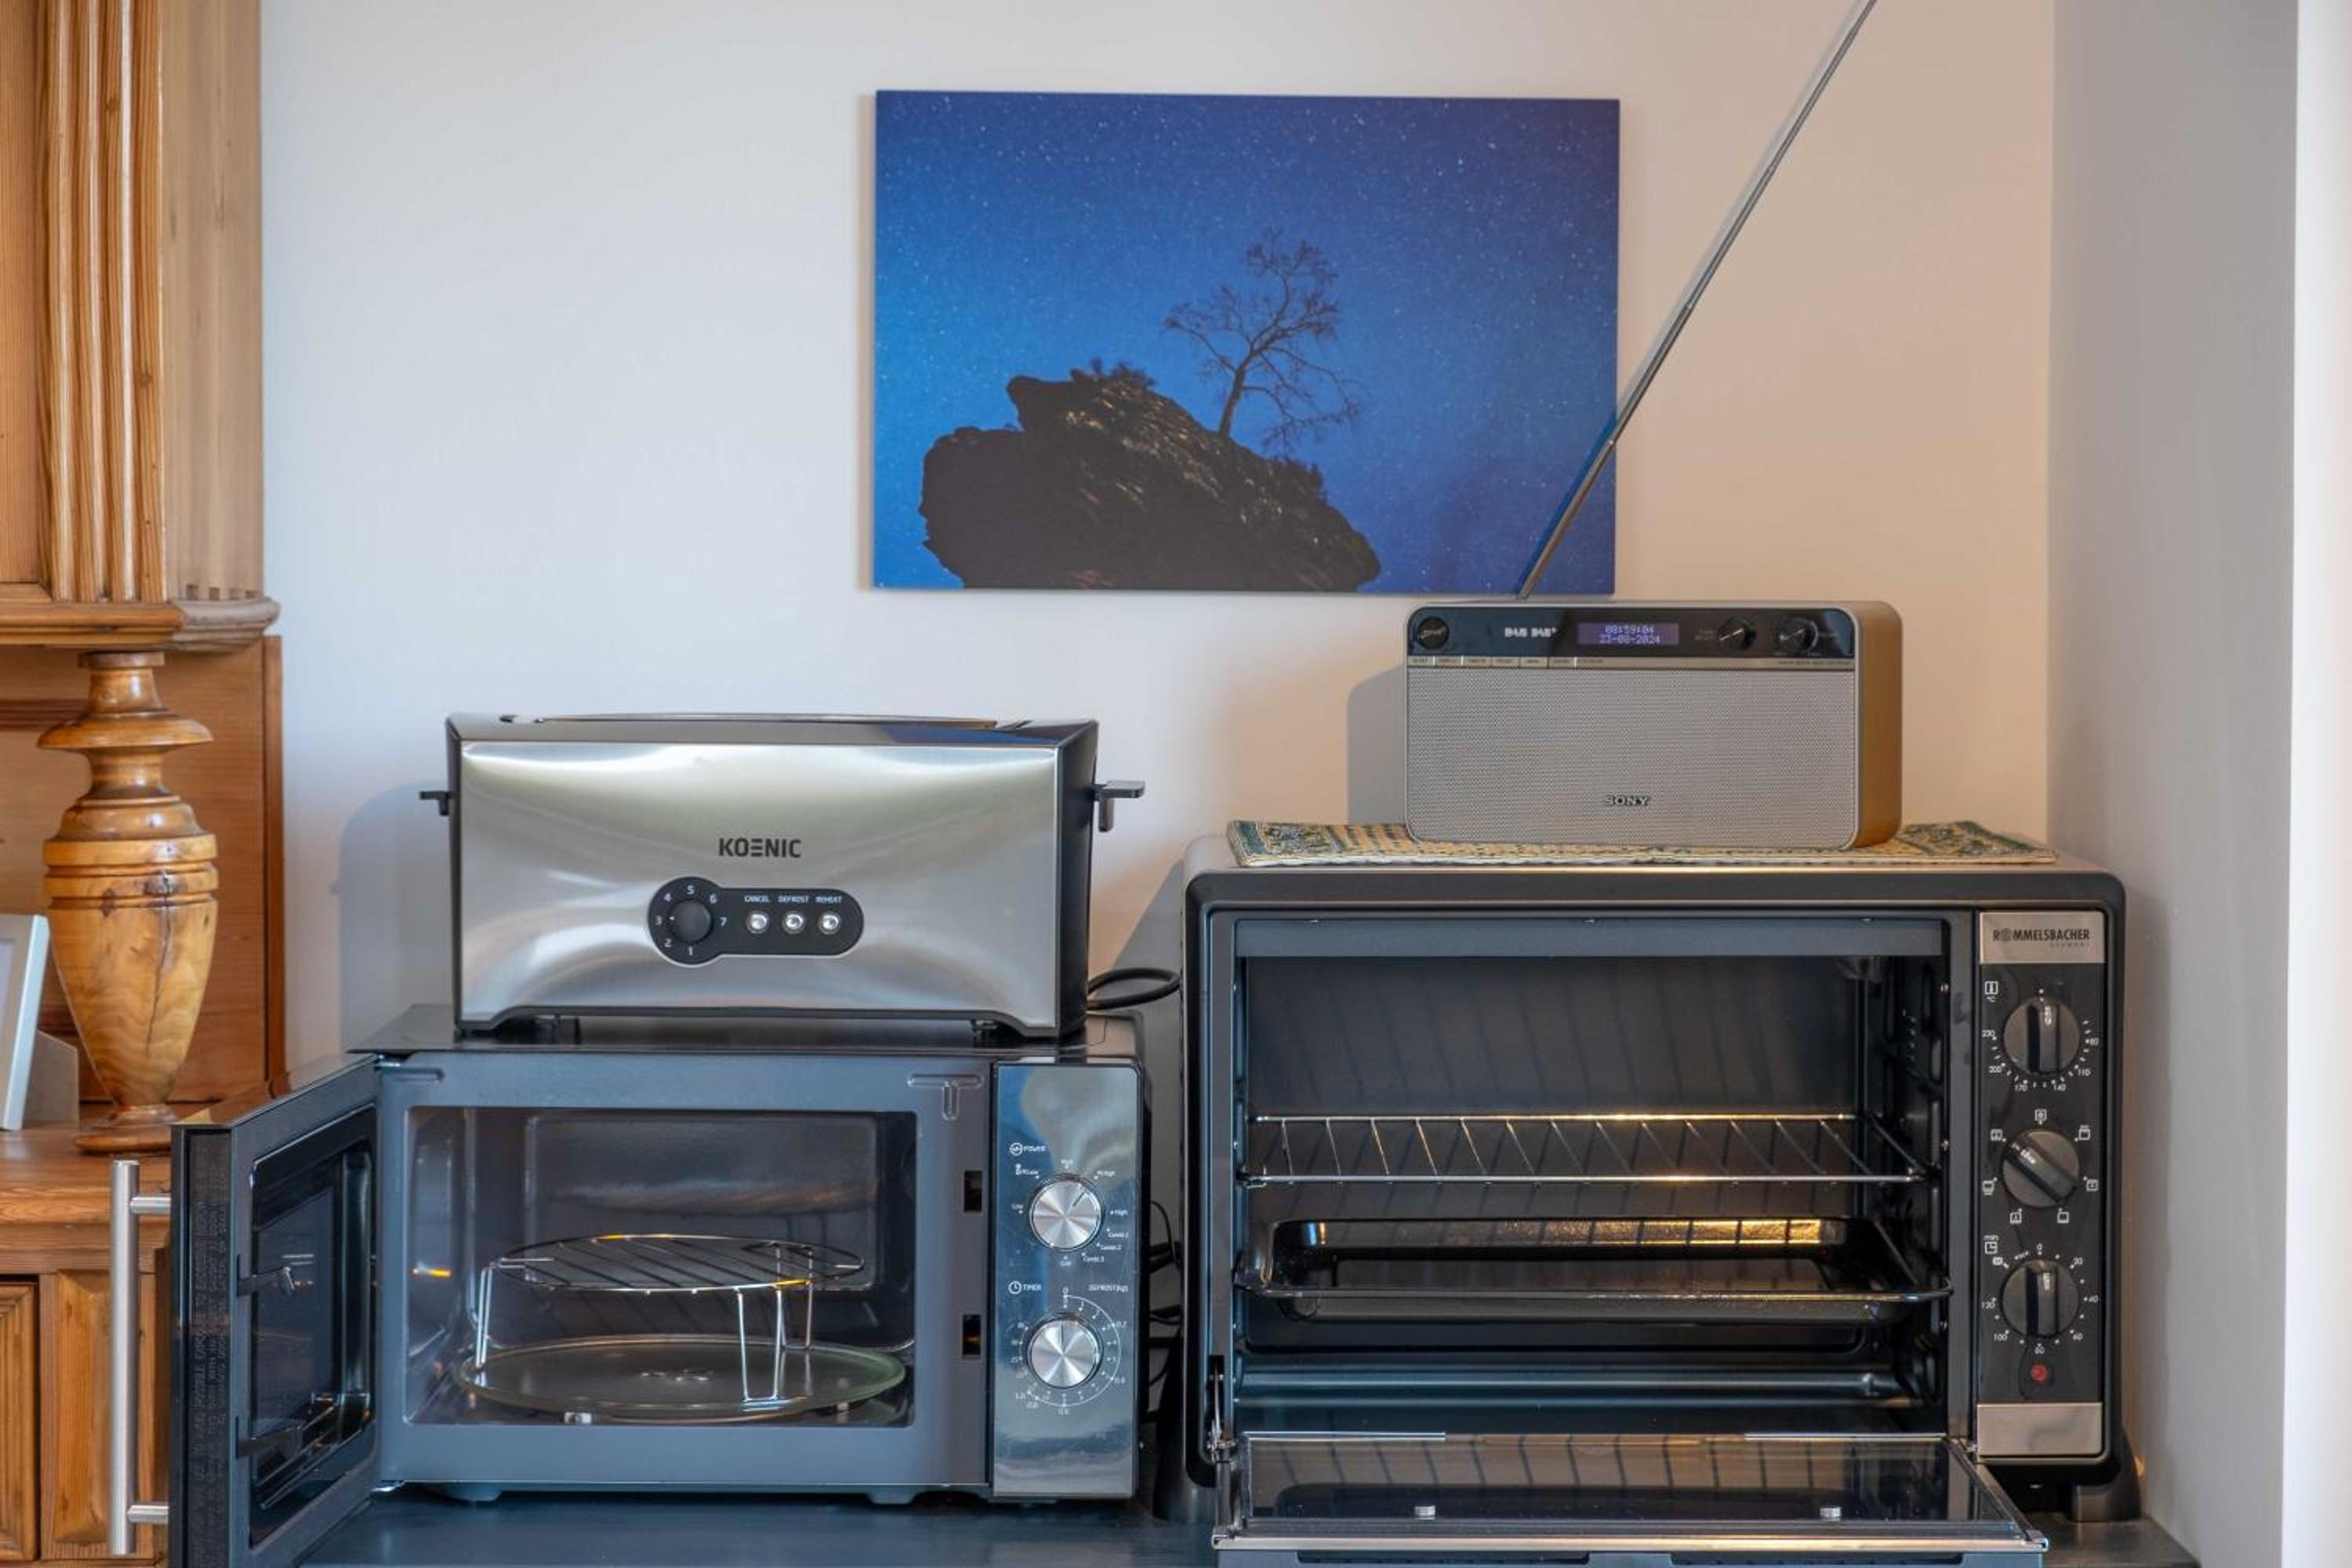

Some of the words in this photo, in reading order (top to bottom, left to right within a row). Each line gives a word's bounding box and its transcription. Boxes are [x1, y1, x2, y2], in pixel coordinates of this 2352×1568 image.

[1605, 794, 1649, 807] SONY
[718, 837, 802, 858] KOENIC
[686, 885, 695, 895] 5
[663, 892, 672, 902] 4
[710, 895, 717, 904] 6
[777, 895, 809, 903] DEFROST
[654, 916, 662, 926] 3
[719, 916, 728, 927] 7
[664, 938, 672, 948] 2
